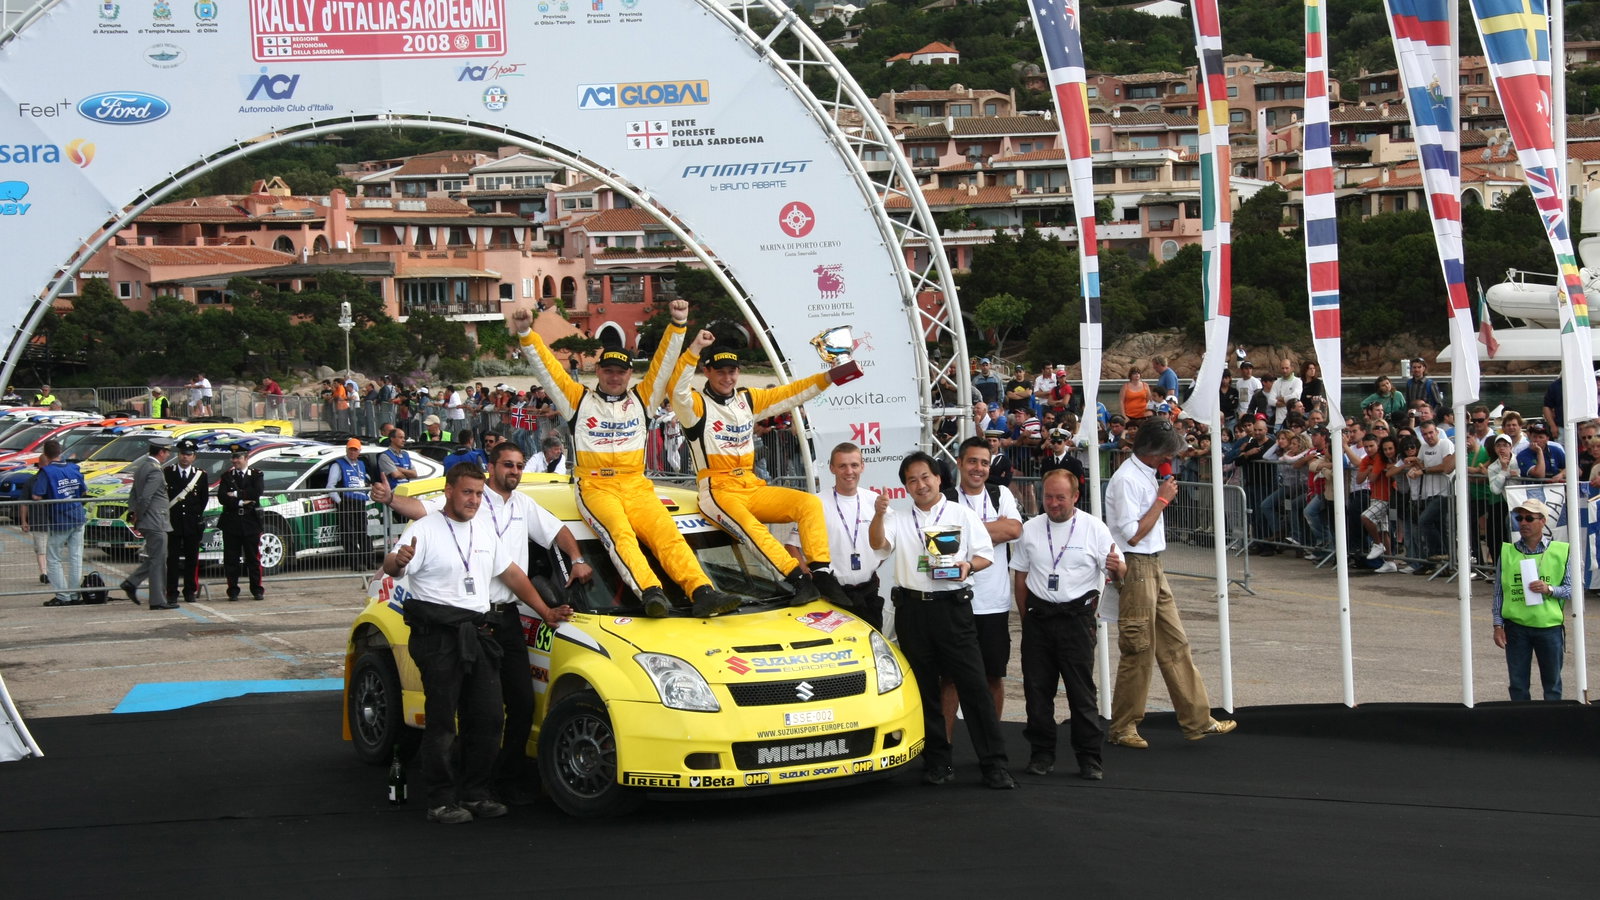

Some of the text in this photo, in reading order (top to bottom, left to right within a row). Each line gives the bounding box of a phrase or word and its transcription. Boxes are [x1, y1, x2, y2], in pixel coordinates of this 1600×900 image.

[258, 0, 314, 32] RALLY
[402, 34, 451, 52] 2008
[579, 82, 708, 108] ACI GLOBAL
[95, 95, 152, 120] Ford
[239, 103, 334, 114] Automobile Club d'Italia
[671, 119, 696, 127] ENTE
[672, 128, 716, 137] FORESTE
[672, 136, 764, 147] DELLA SARDEGNA
[682, 160, 813, 178] PRIMATIST
[719, 181, 750, 191] BRUNO
[751, 180, 787, 189] ABBATE
[760, 243, 786, 251] MARINA
[795, 242, 818, 250] PORTO
[819, 240, 841, 248] CERVO
[831, 302, 854, 310] HOTEL
[828, 391, 907, 407] wokita.com
[600, 417, 640, 430] SUZUKI
[536, 623, 553, 651] 35
[751, 649, 853, 667] SUZUKI SPORT
[782, 663, 837, 673] EUROPE
[792, 710, 833, 724] SSE-002
[757, 721, 859, 738] WWW.SUZUKISPORT-EUROPE.COM
[757, 738, 850, 765] MICHAL
[888, 753, 907, 766] Beta
[779, 766, 840, 779] SUZUKI SPORT
[853, 761, 872, 773] OMP
[623, 772, 681, 787] PIRELLI
[702, 775, 735, 787] Beta
[746, 772, 768, 785] OMP
